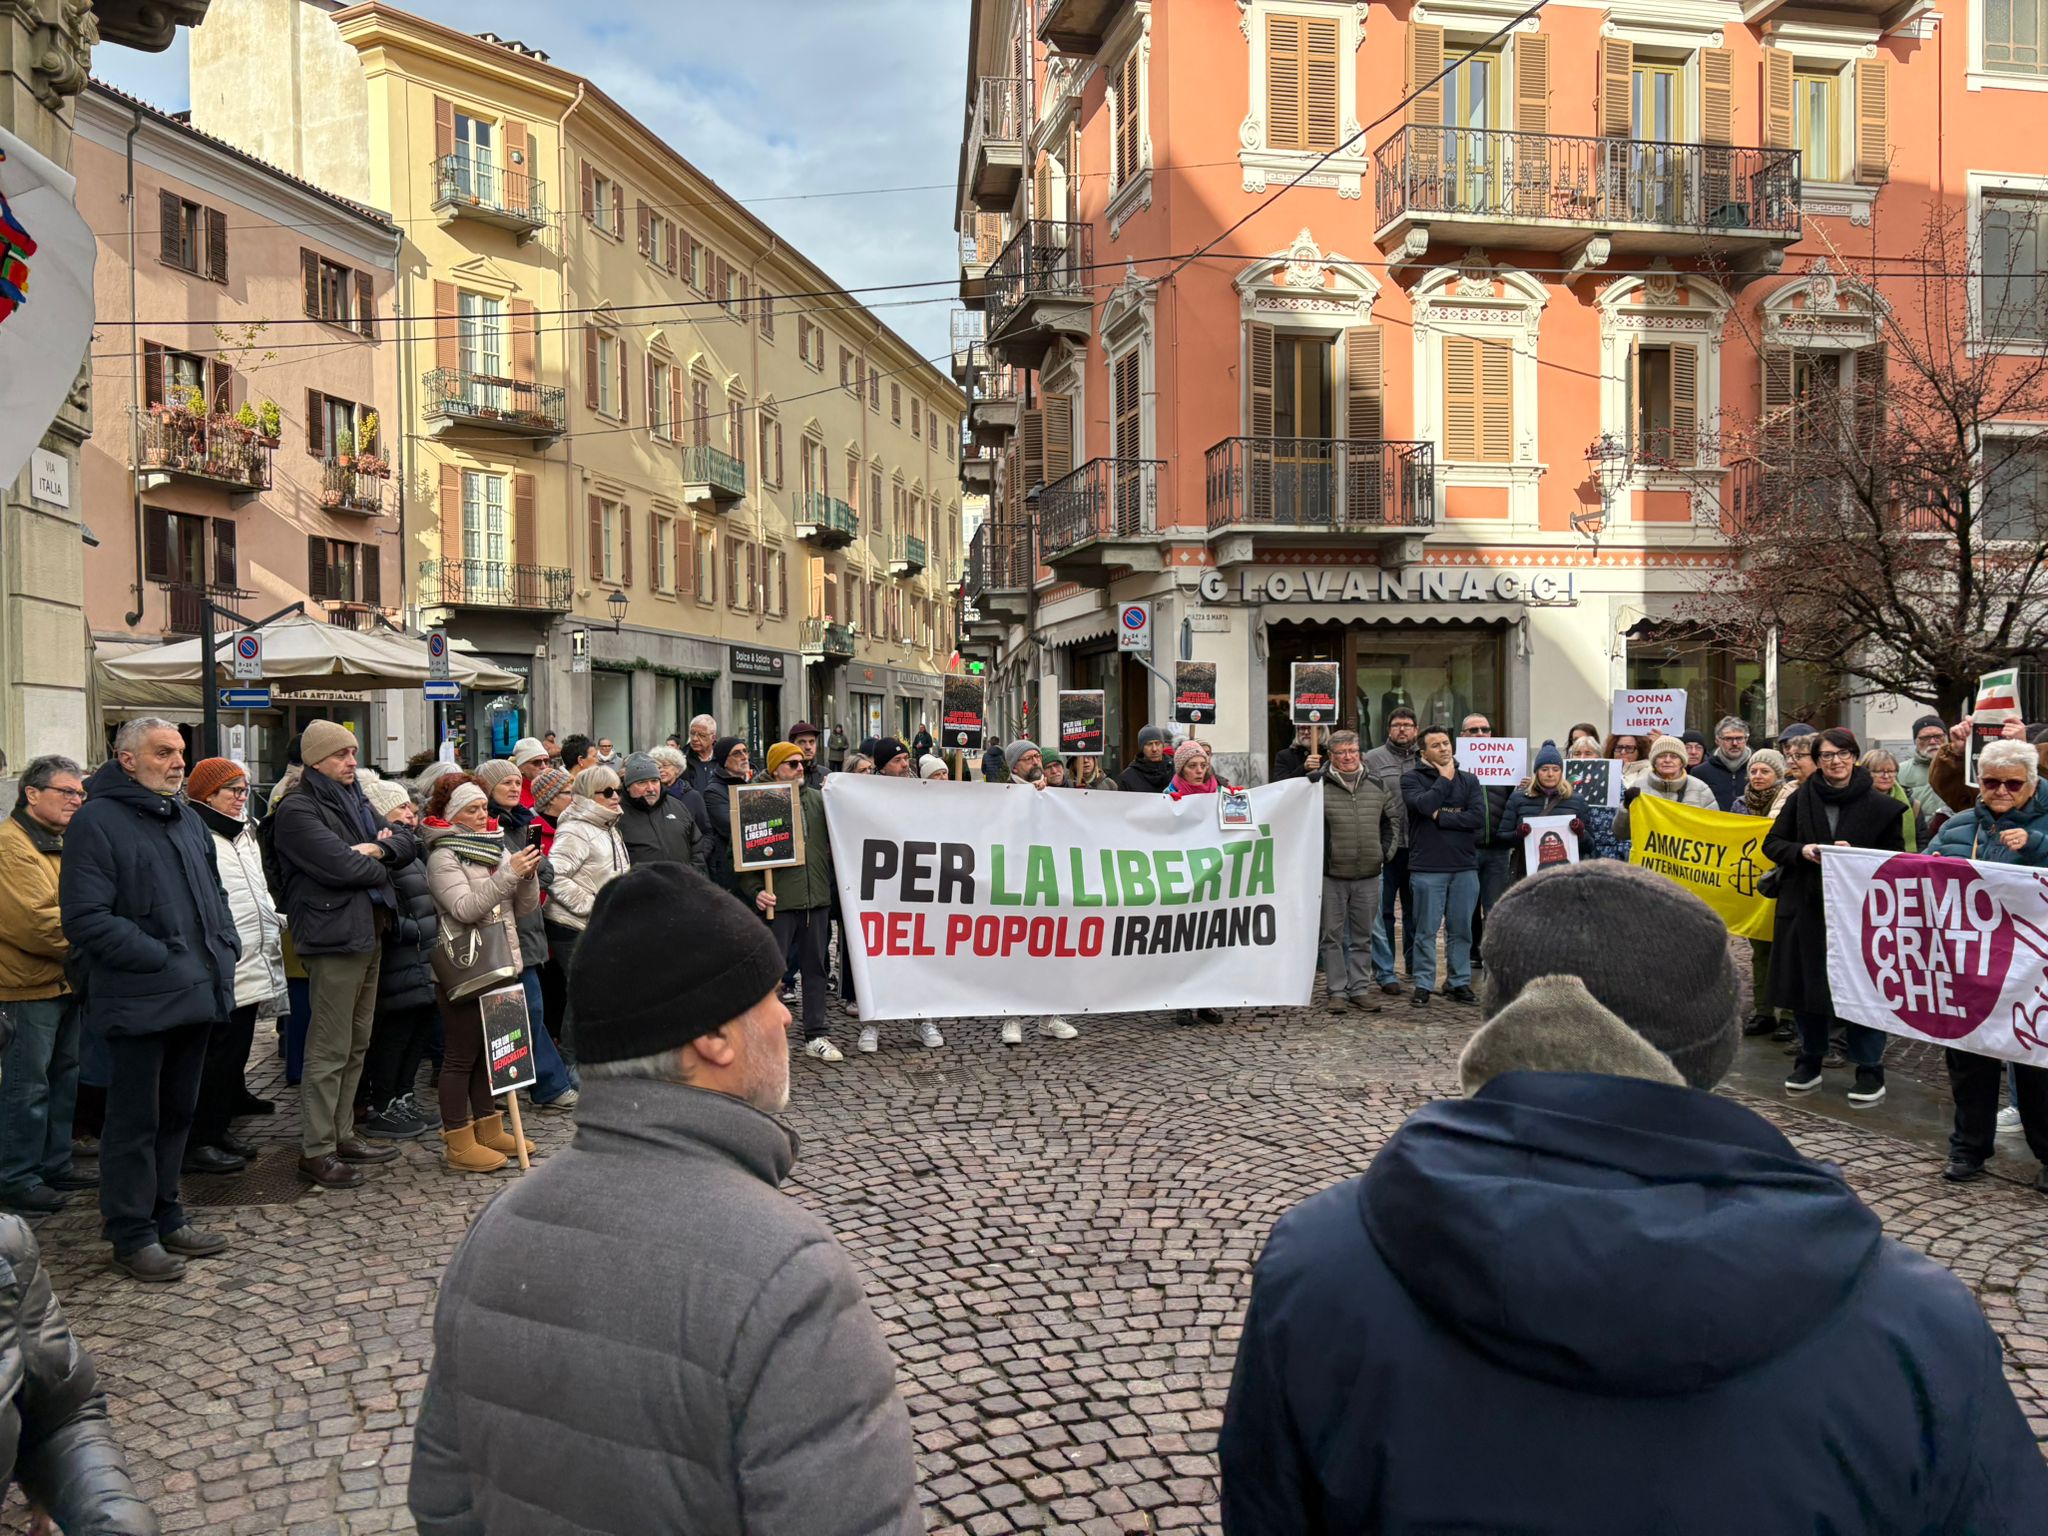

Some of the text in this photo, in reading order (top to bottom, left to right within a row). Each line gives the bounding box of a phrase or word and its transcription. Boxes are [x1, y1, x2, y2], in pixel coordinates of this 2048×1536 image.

[46, 460, 55, 474] VIA
[40, 477, 62, 496] ITALIA
[1200, 570, 1579, 600] GIOVANNACCI
[310, 692, 363, 700] ARTIGIANALE
[1627, 694, 1673, 703] DONNA
[1637, 706, 1663, 715] VITA
[1063, 721, 1073, 729] PER
[1063, 727, 1082, 735] LIBERO
[1470, 743, 1514, 751] DONNA
[1479, 755, 1504, 763] VITA
[745, 818, 783, 833] PER UN IRAN
[745, 827, 773, 841] LIBERO E
[746, 832, 790, 849] DEMOCRATICO
[1644, 830, 1728, 868] AMNESTY
[860, 824, 1275, 907] PER LA LIBERTÀ
[1641, 856, 1721, 887] INTERNATIONAL
[1868, 877, 2003, 932] DEMO
[860, 904, 1276, 957] DEL POPOLO IRANIANO
[1871, 927, 1992, 976] CRATI
[1876, 967, 1967, 1018] CHE.
[491, 1028, 521, 1050] PER UN IRAN
[492, 1043, 511, 1061] LIBERO
[494, 1046, 528, 1071] DEMOCRATICO
